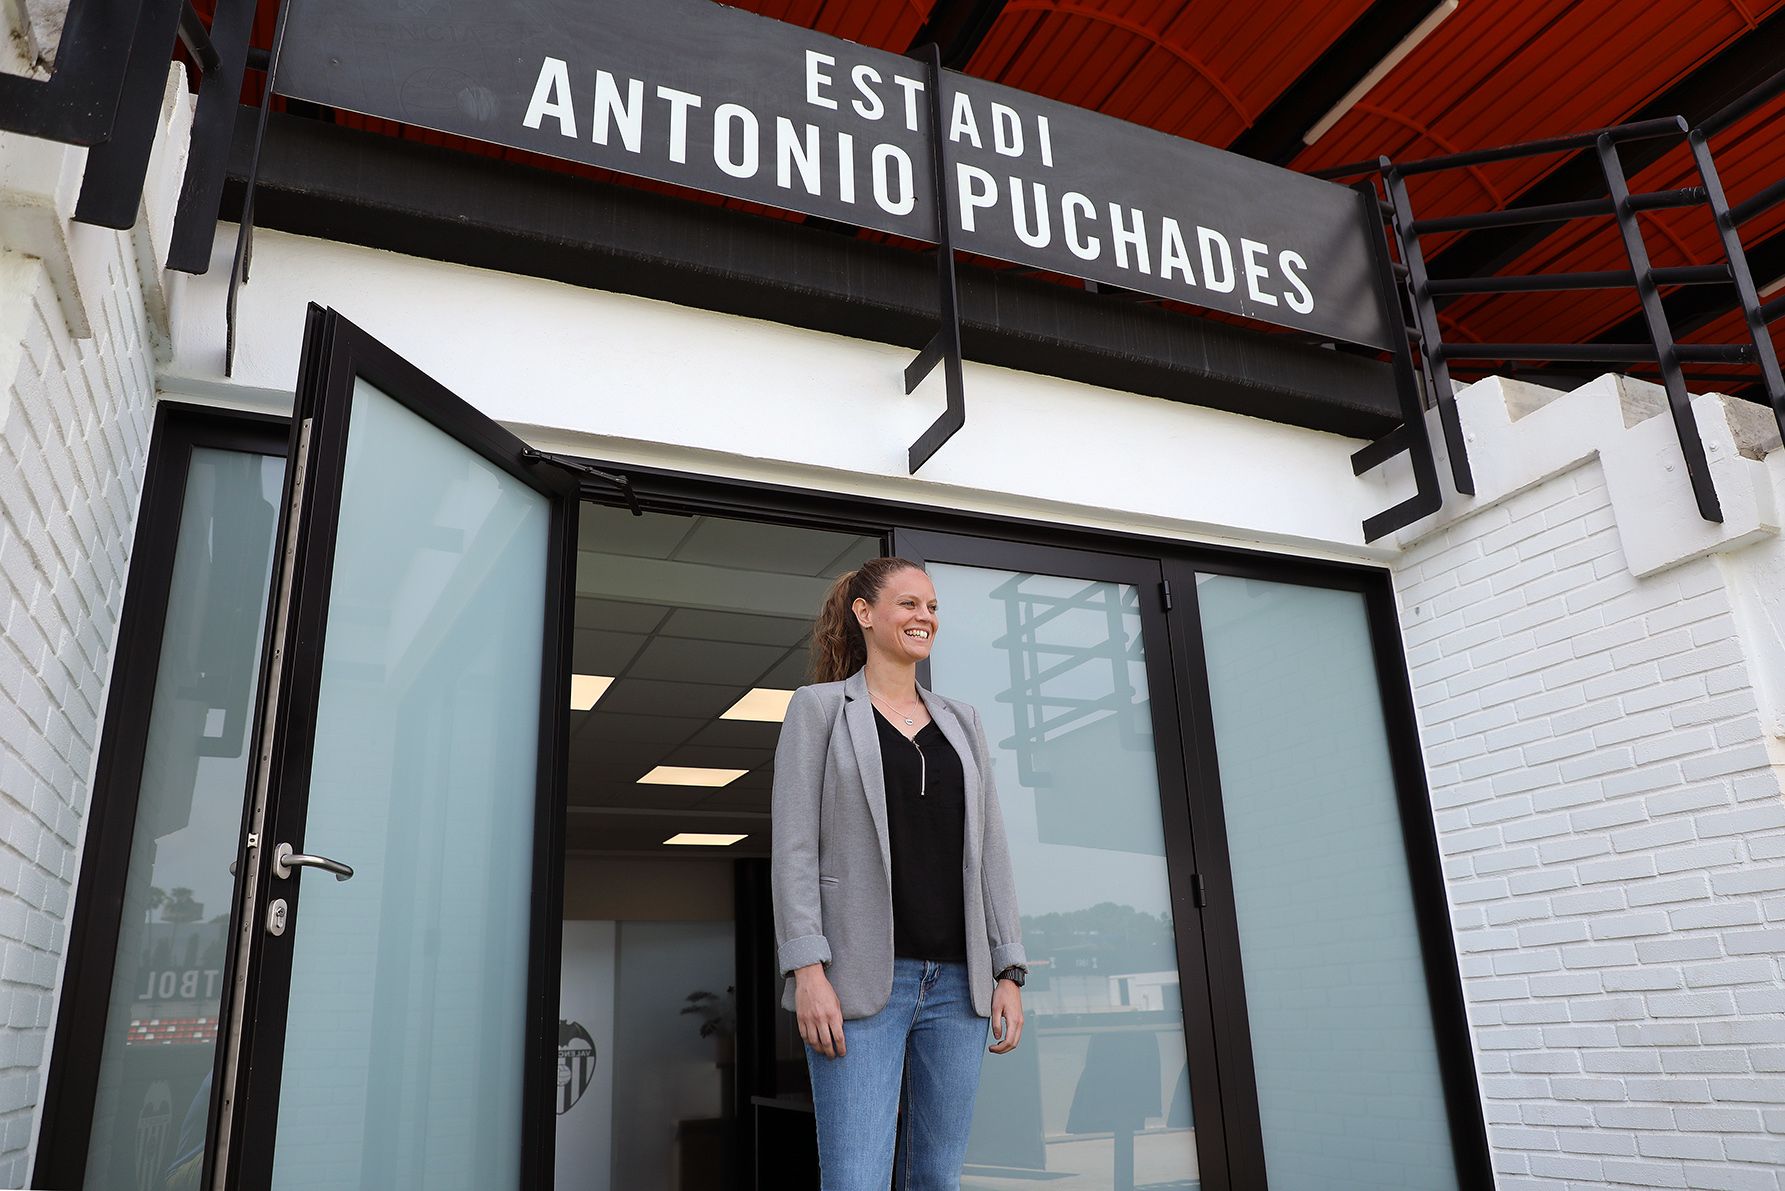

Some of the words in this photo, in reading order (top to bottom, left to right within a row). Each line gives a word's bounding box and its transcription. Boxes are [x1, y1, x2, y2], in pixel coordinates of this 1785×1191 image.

[523, 57, 916, 216] ANTONIO
[957, 163, 1315, 314] PUCHADES
[806, 50, 1053, 167] ESTADI
